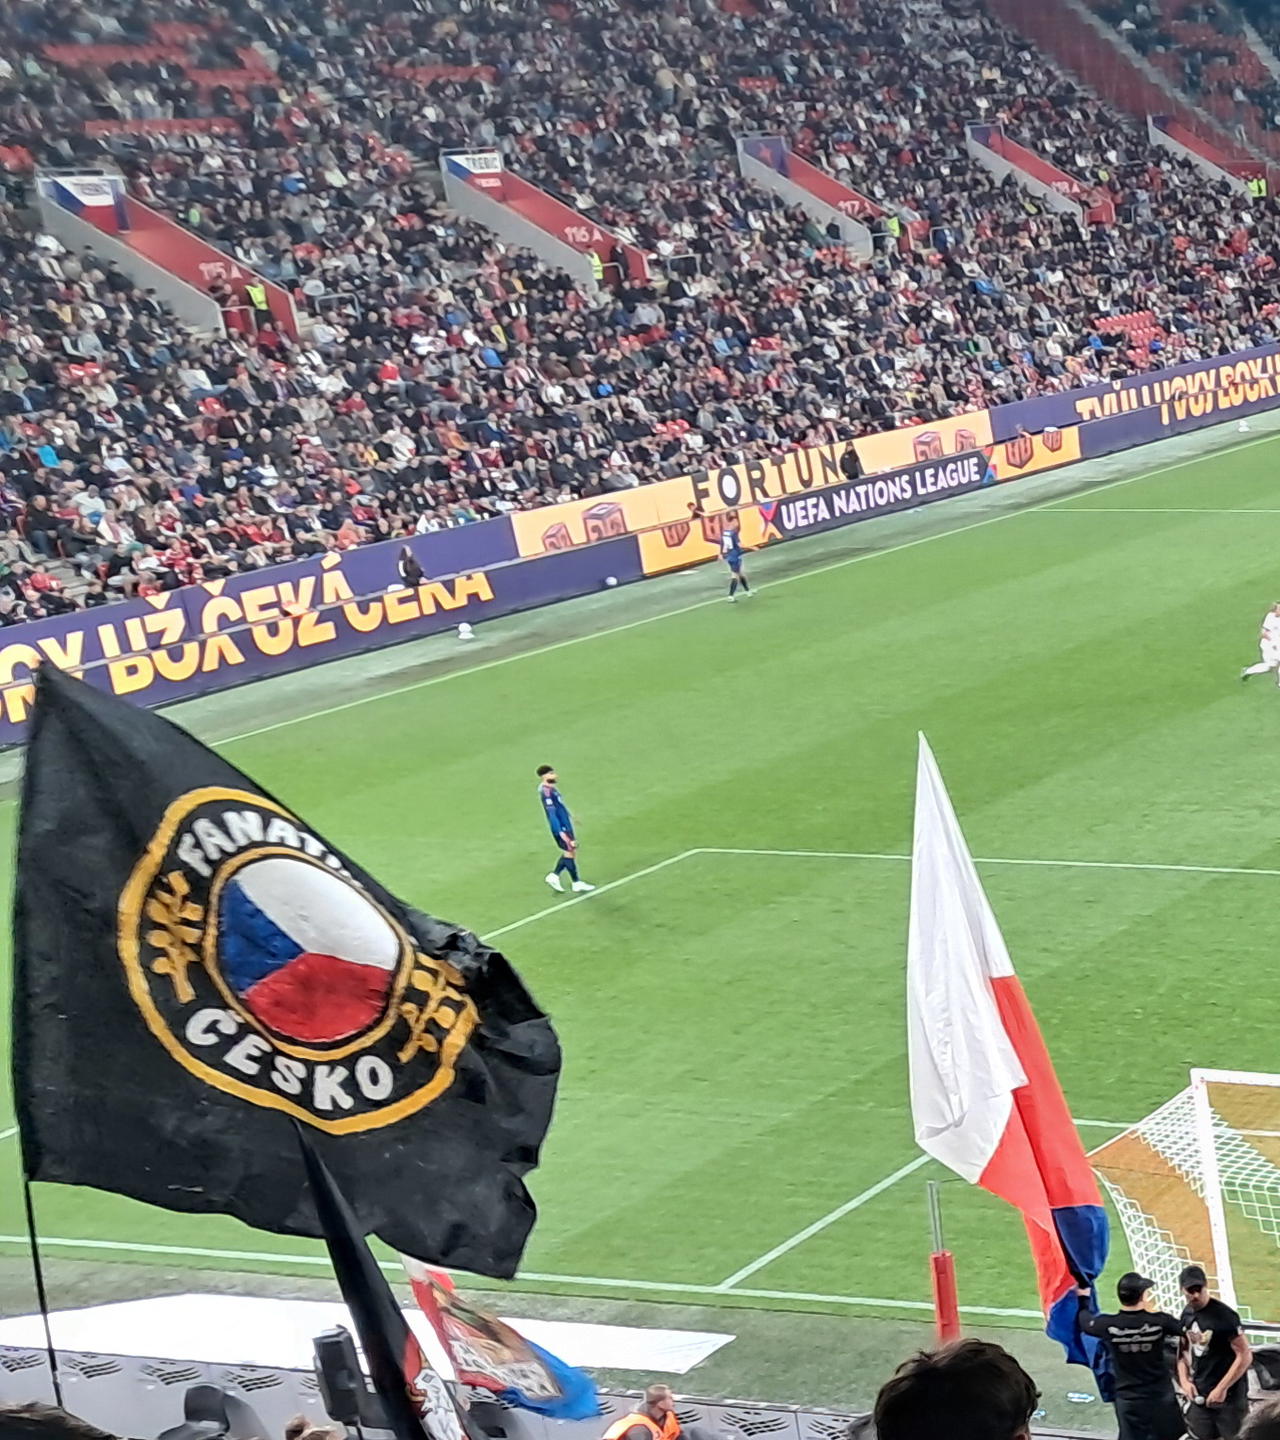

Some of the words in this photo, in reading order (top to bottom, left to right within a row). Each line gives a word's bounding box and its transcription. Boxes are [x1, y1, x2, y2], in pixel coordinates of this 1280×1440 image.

[691, 441, 866, 514] FORTUN
[780, 501, 831, 531] UEFA
[832, 474, 912, 517] NATIONS
[914, 456, 981, 496] LEAGUE
